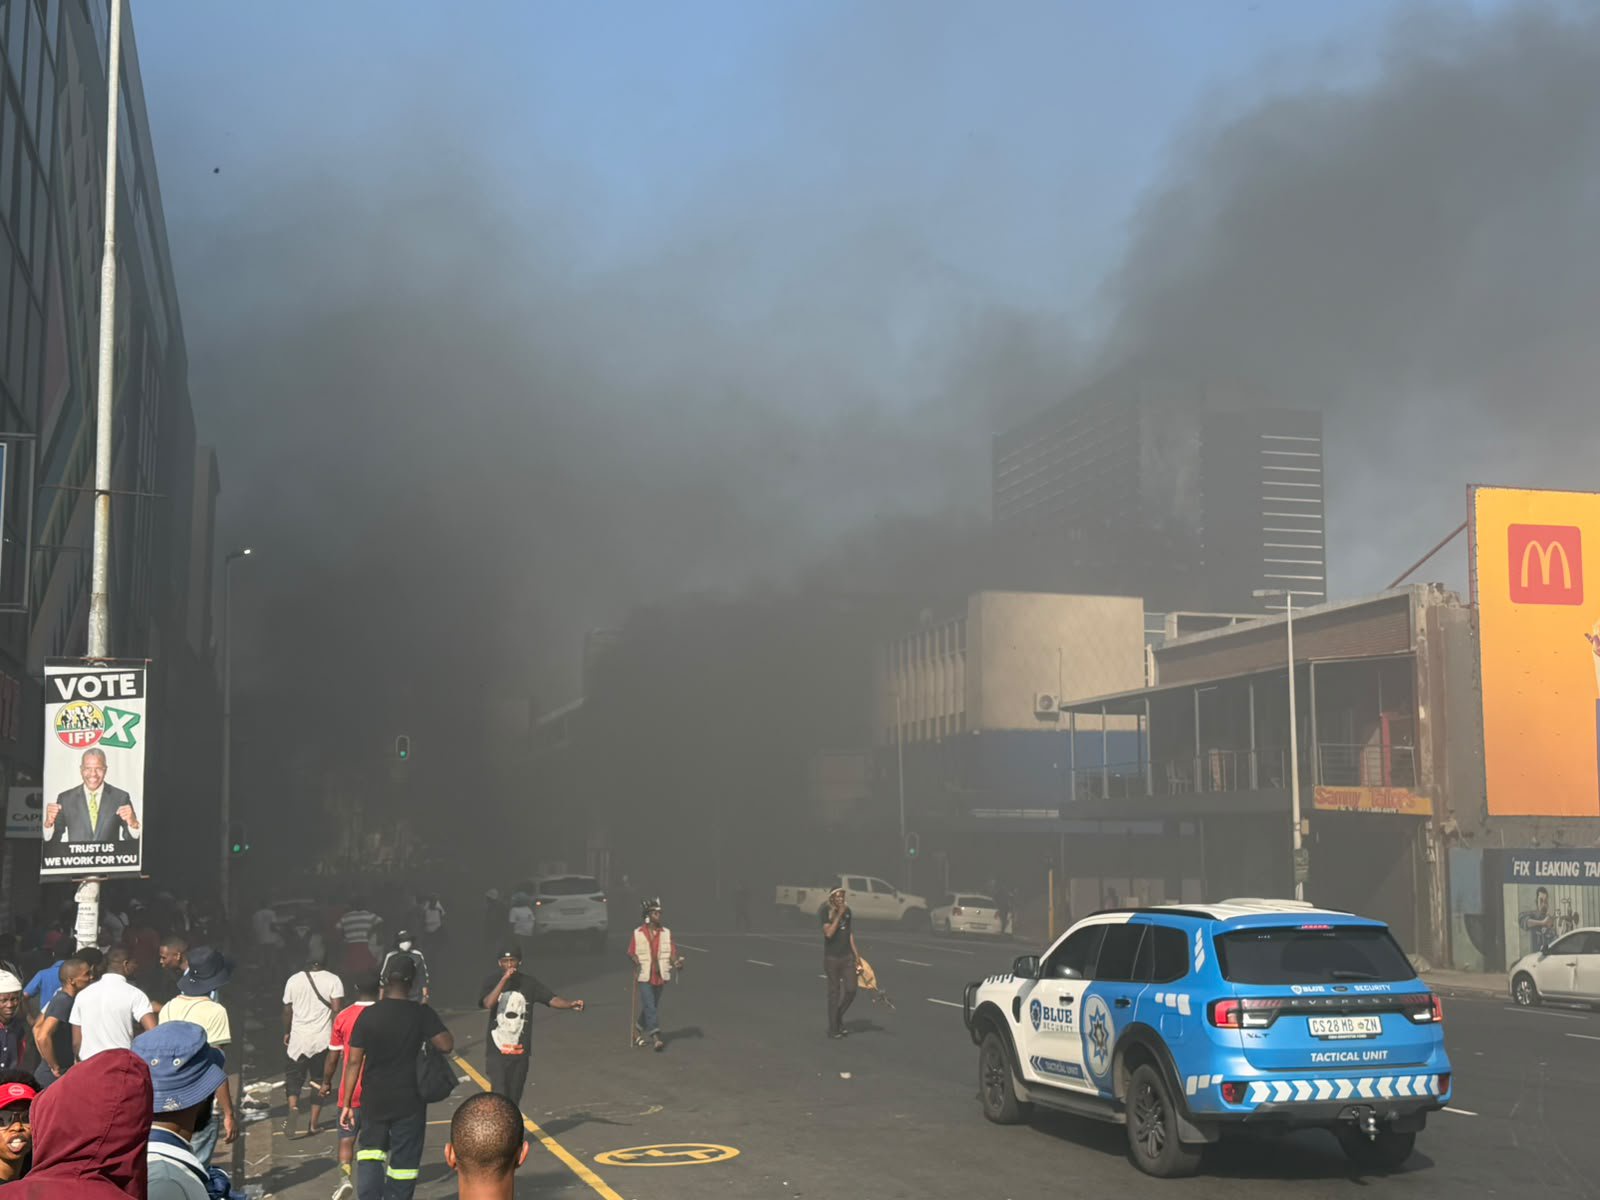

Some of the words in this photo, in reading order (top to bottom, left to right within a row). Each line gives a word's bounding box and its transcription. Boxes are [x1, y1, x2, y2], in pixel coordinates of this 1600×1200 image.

[54, 673, 136, 700] VOTE
[68, 731, 96, 744] IFP
[69, 844, 100, 853] TRUST
[101, 843, 114, 852] US
[44, 857, 61, 866] WE
[62, 856, 94, 866] WORK
[95, 855, 114, 864] FOR
[116, 854, 137, 863] YOU
[1535, 861, 1580, 877] LEAKING
[1354, 984, 1391, 992] SECURITY
[1291, 997, 1393, 1006] EVEREST
[1043, 1006, 1072, 1024] BLUE
[1043, 1021, 1073, 1033] SECURITY
[1312, 1020, 1326, 1033] CS
[1327, 1019, 1340, 1033] 28
[1364, 1018, 1378, 1032] ZN
[1311, 1051, 1359, 1063] TACTICAL
[1362, 1050, 1388, 1061] UNIT
